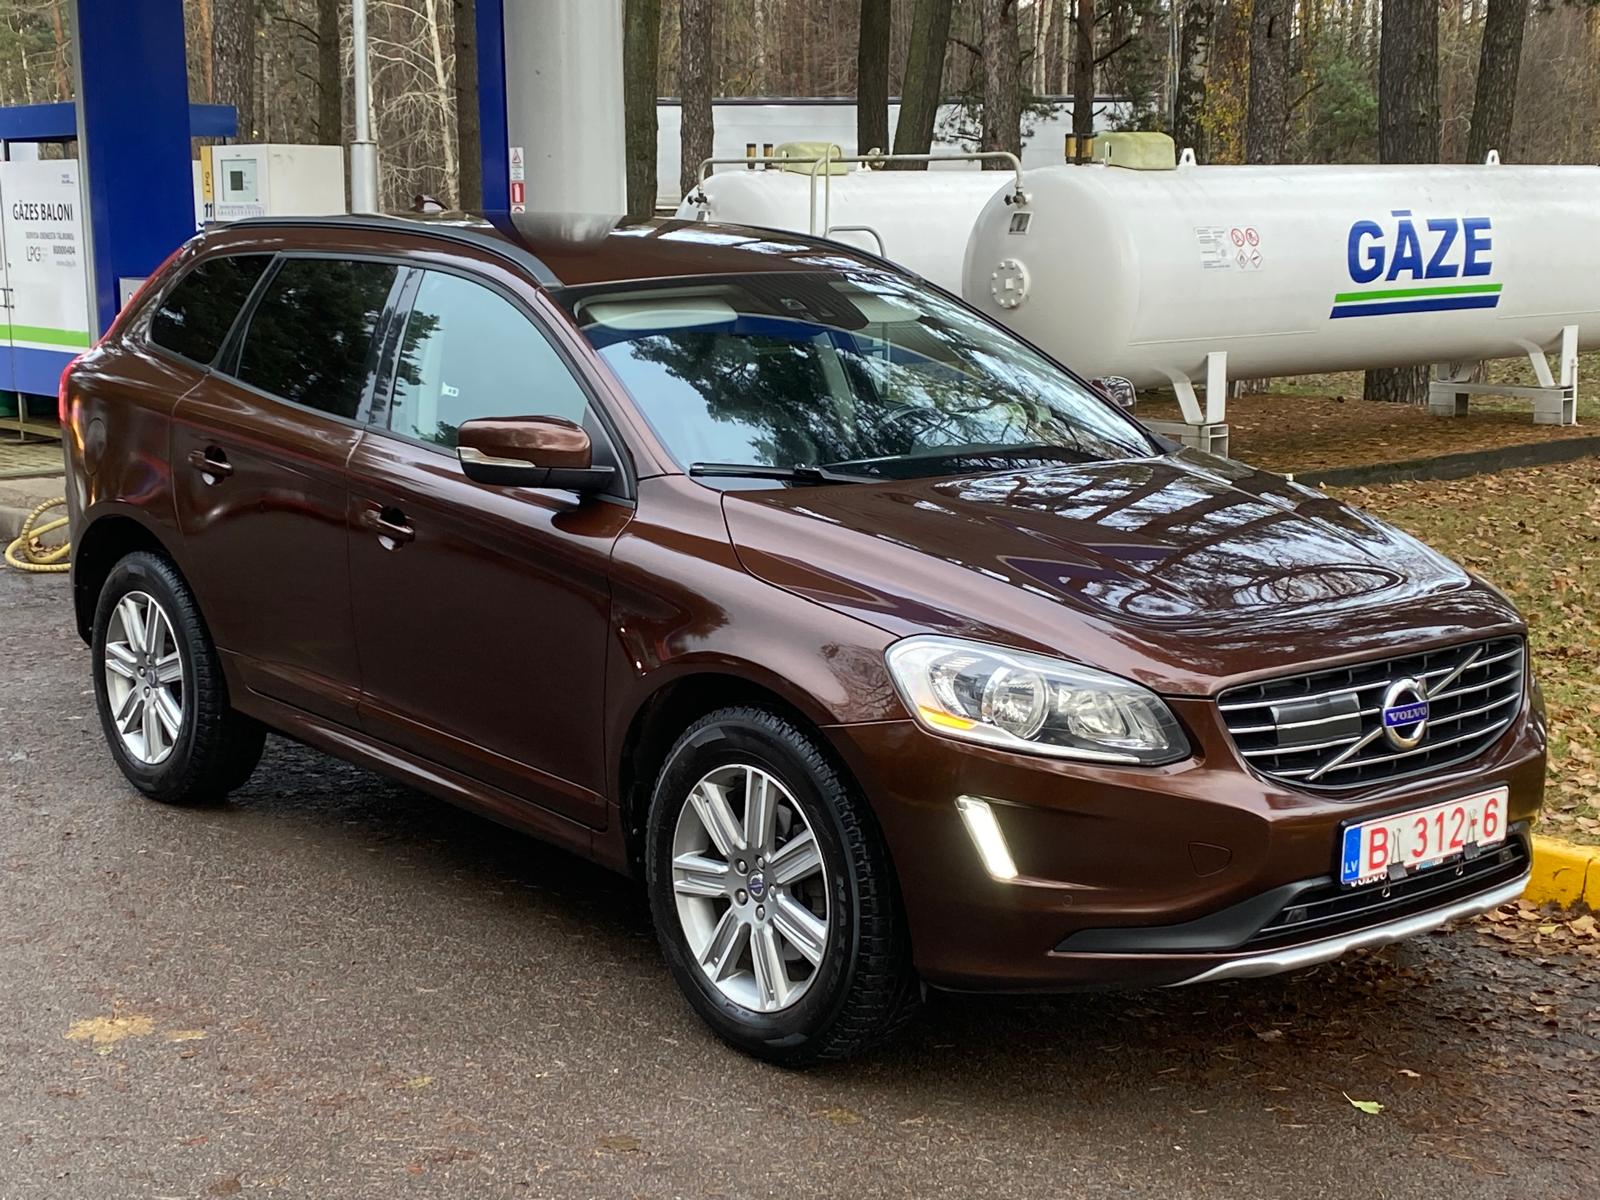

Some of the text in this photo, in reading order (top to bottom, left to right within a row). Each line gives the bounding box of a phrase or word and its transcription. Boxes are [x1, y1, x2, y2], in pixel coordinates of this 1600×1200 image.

[12, 199, 74, 221] GĀZES BALONI
[204, 202, 213, 218] 11
[26, 245, 41, 262] LPG
[1347, 209, 1493, 284] GĀZE
[1388, 706, 1428, 722] VOLVO
[1345, 859, 1359, 874] LV
